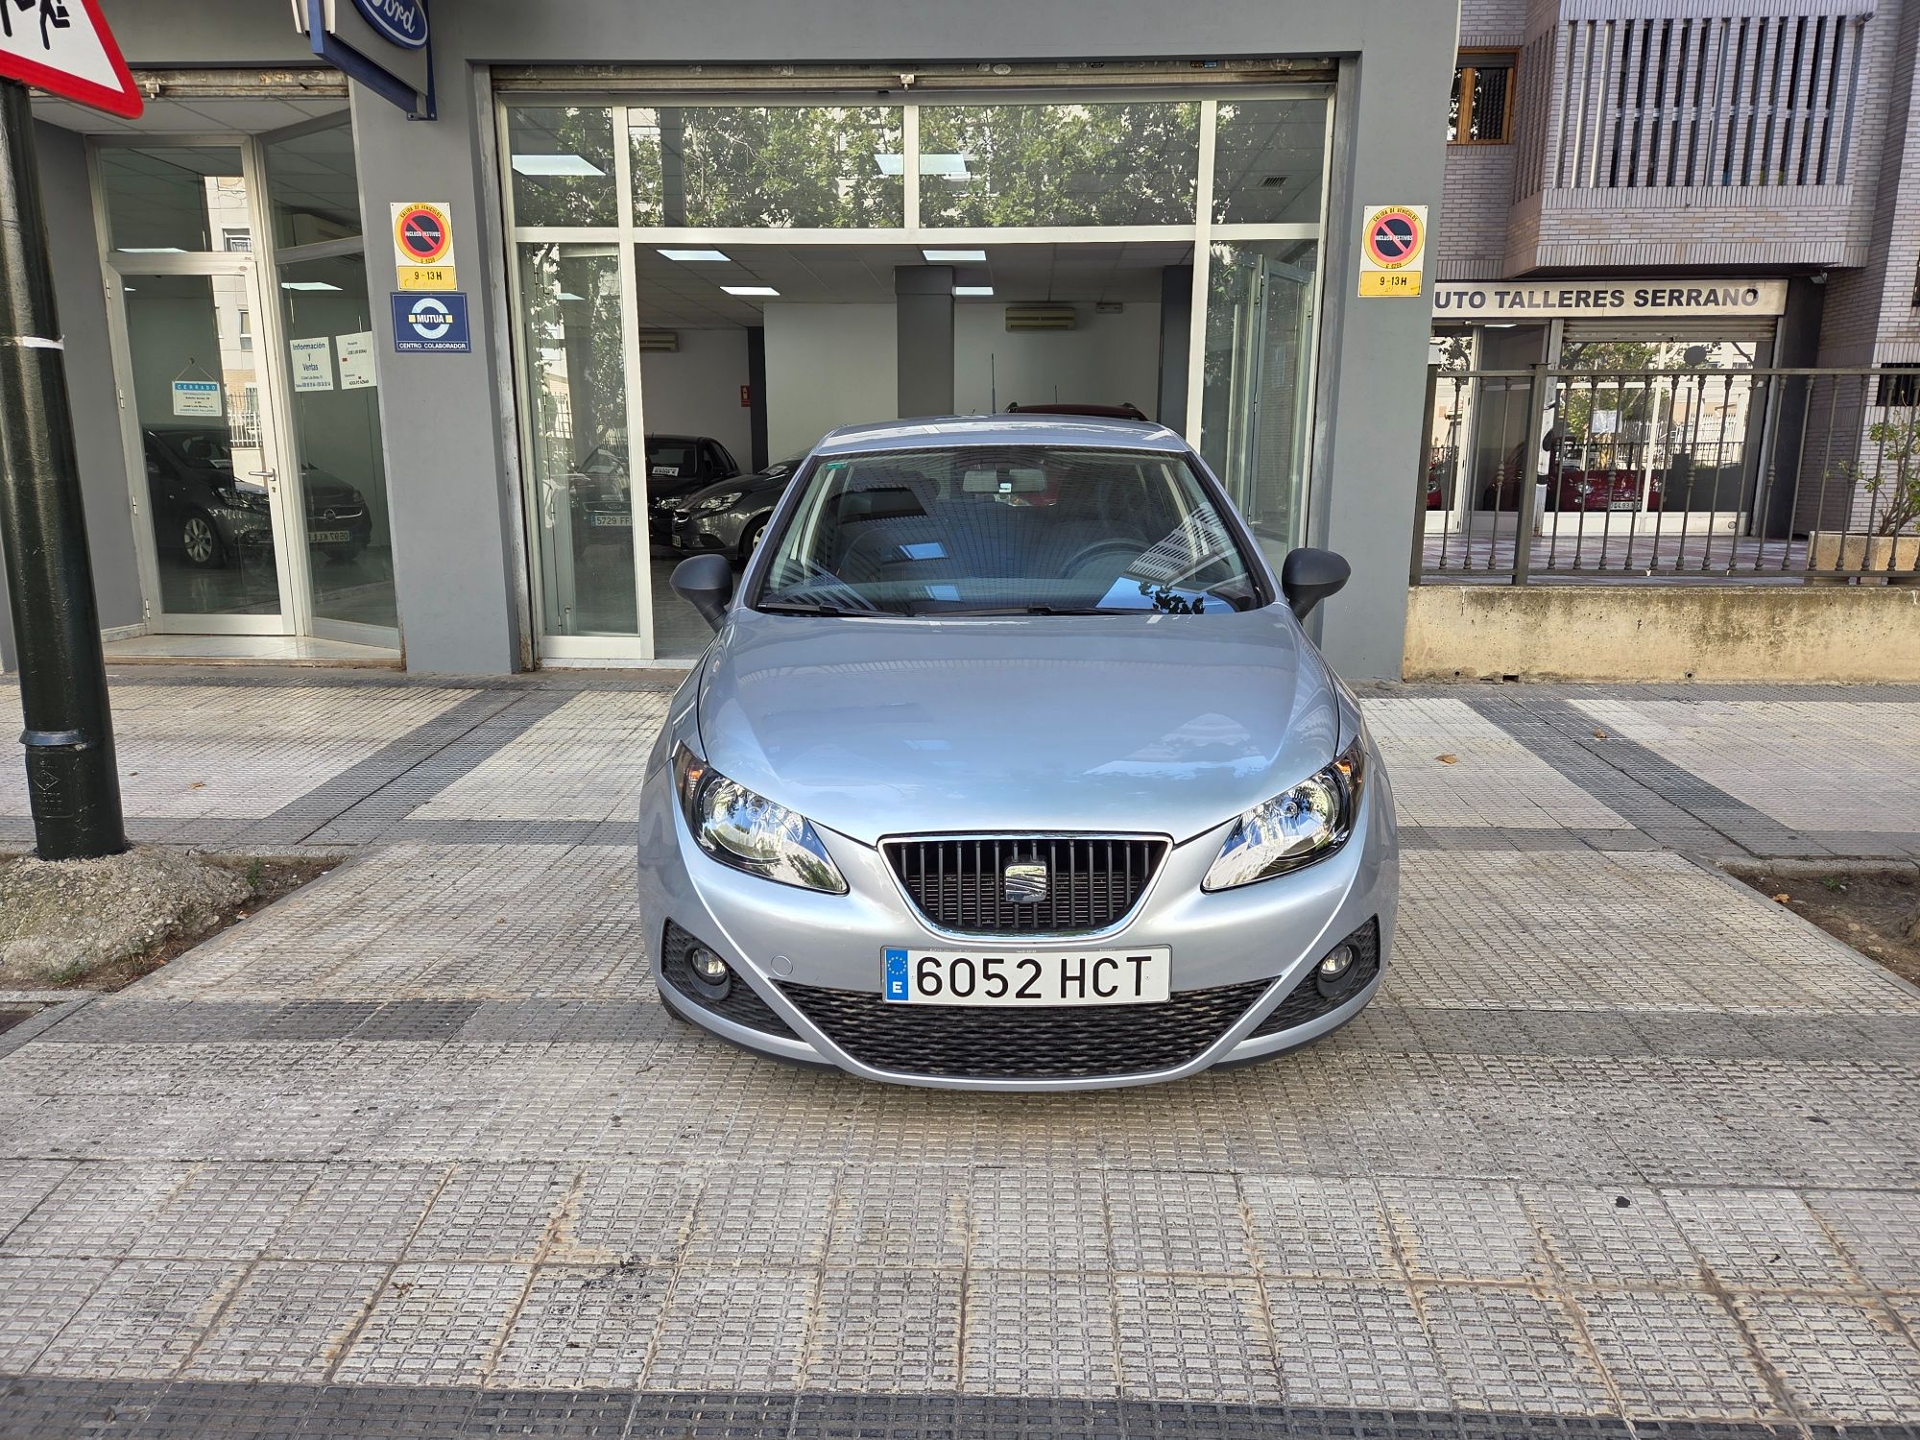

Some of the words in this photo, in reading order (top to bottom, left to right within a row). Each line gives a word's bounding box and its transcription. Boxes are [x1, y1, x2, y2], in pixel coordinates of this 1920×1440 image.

[1494, 289, 1624, 309] TALLERES
[1633, 287, 1760, 308] SERRANO
[416, 314, 444, 323] MUTUA
[292, 342, 326, 351] Información
[302, 363, 319, 371] Ventas
[596, 516, 617, 525] 5729
[892, 981, 902, 994] E
[916, 956, 1042, 999] 6052
[1060, 955, 1152, 999] HCT
